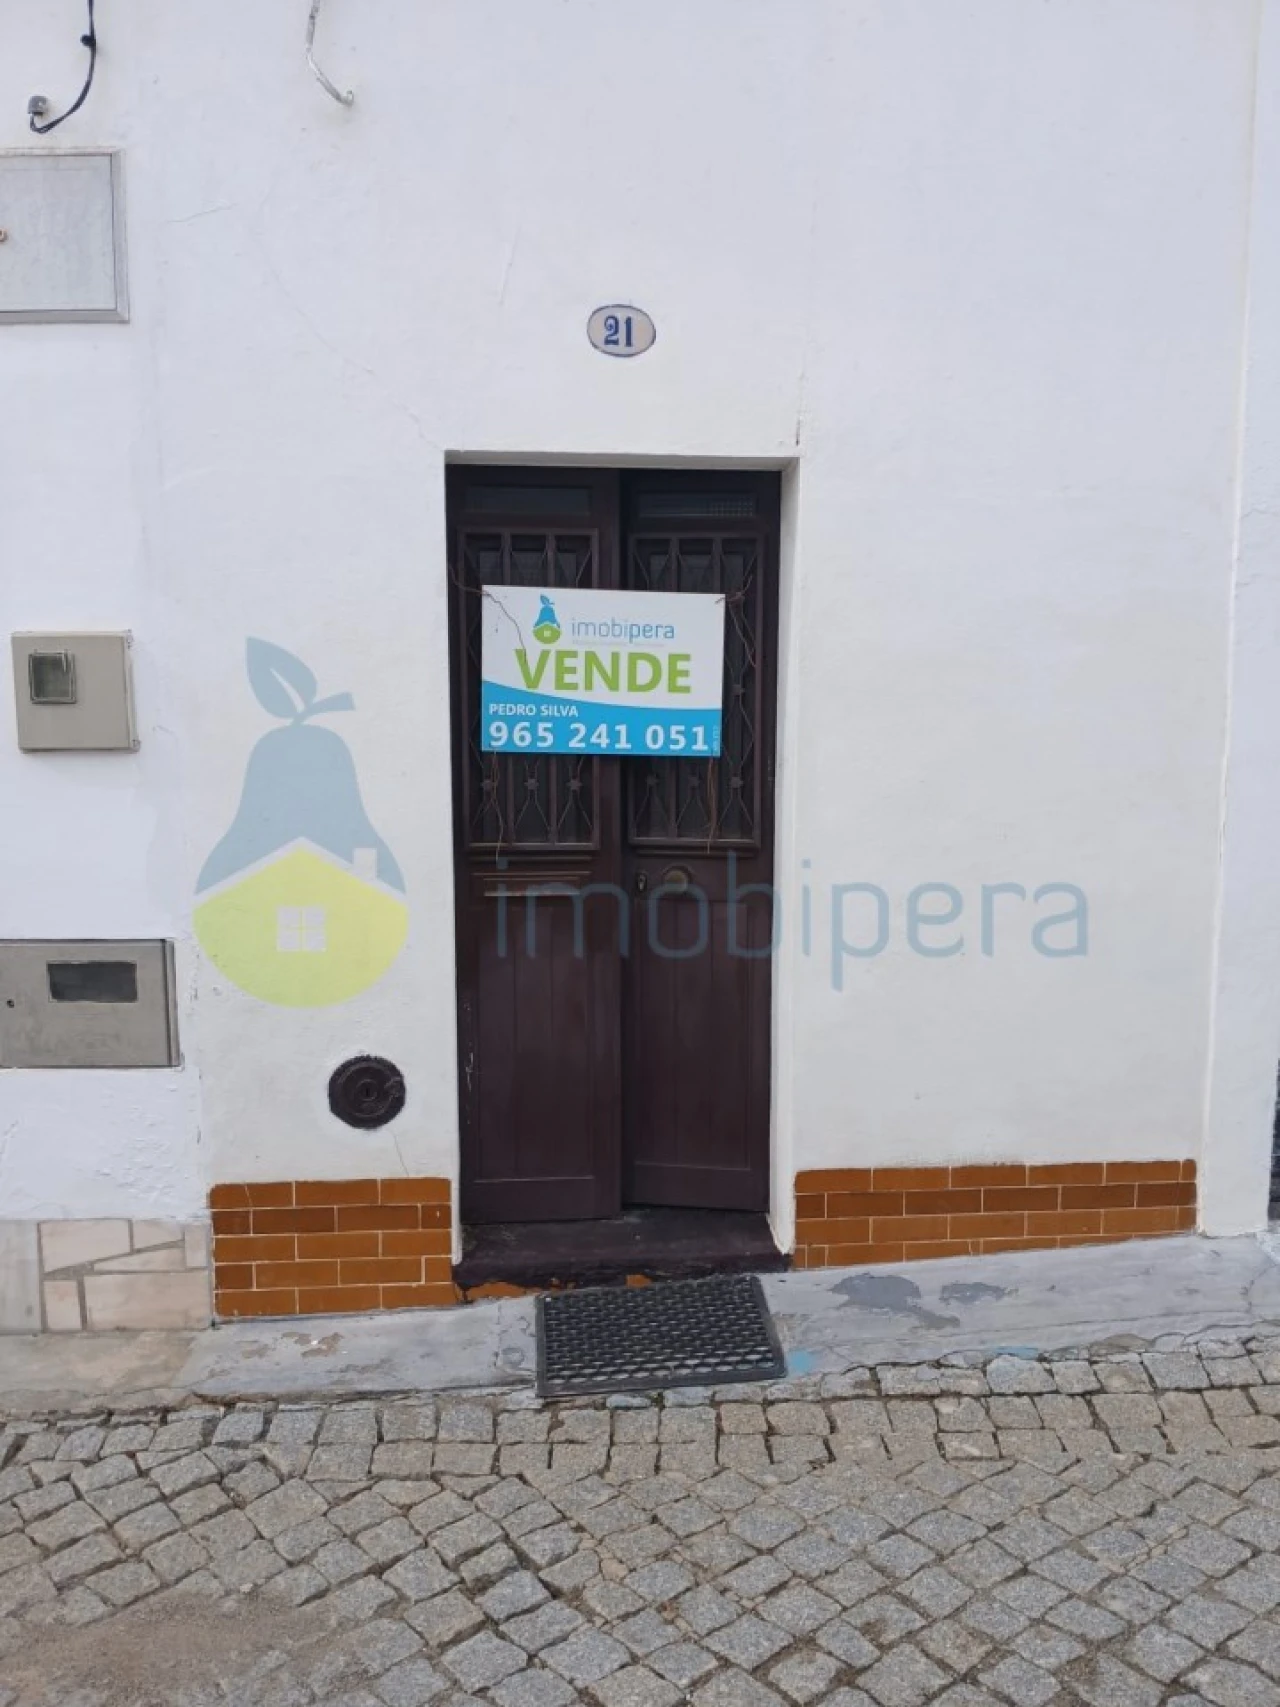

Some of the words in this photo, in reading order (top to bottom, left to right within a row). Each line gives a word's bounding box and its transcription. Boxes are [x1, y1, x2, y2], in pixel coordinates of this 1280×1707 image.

[603, 314, 633, 348] 21
[571, 617, 675, 643] imobipera
[514, 649, 692, 694] VENDE
[488, 703, 536, 716] PEDRO
[540, 704, 579, 717] SILVA
[488, 721, 554, 747] 965
[568, 723, 632, 748] 241
[645, 724, 709, 751] 051
